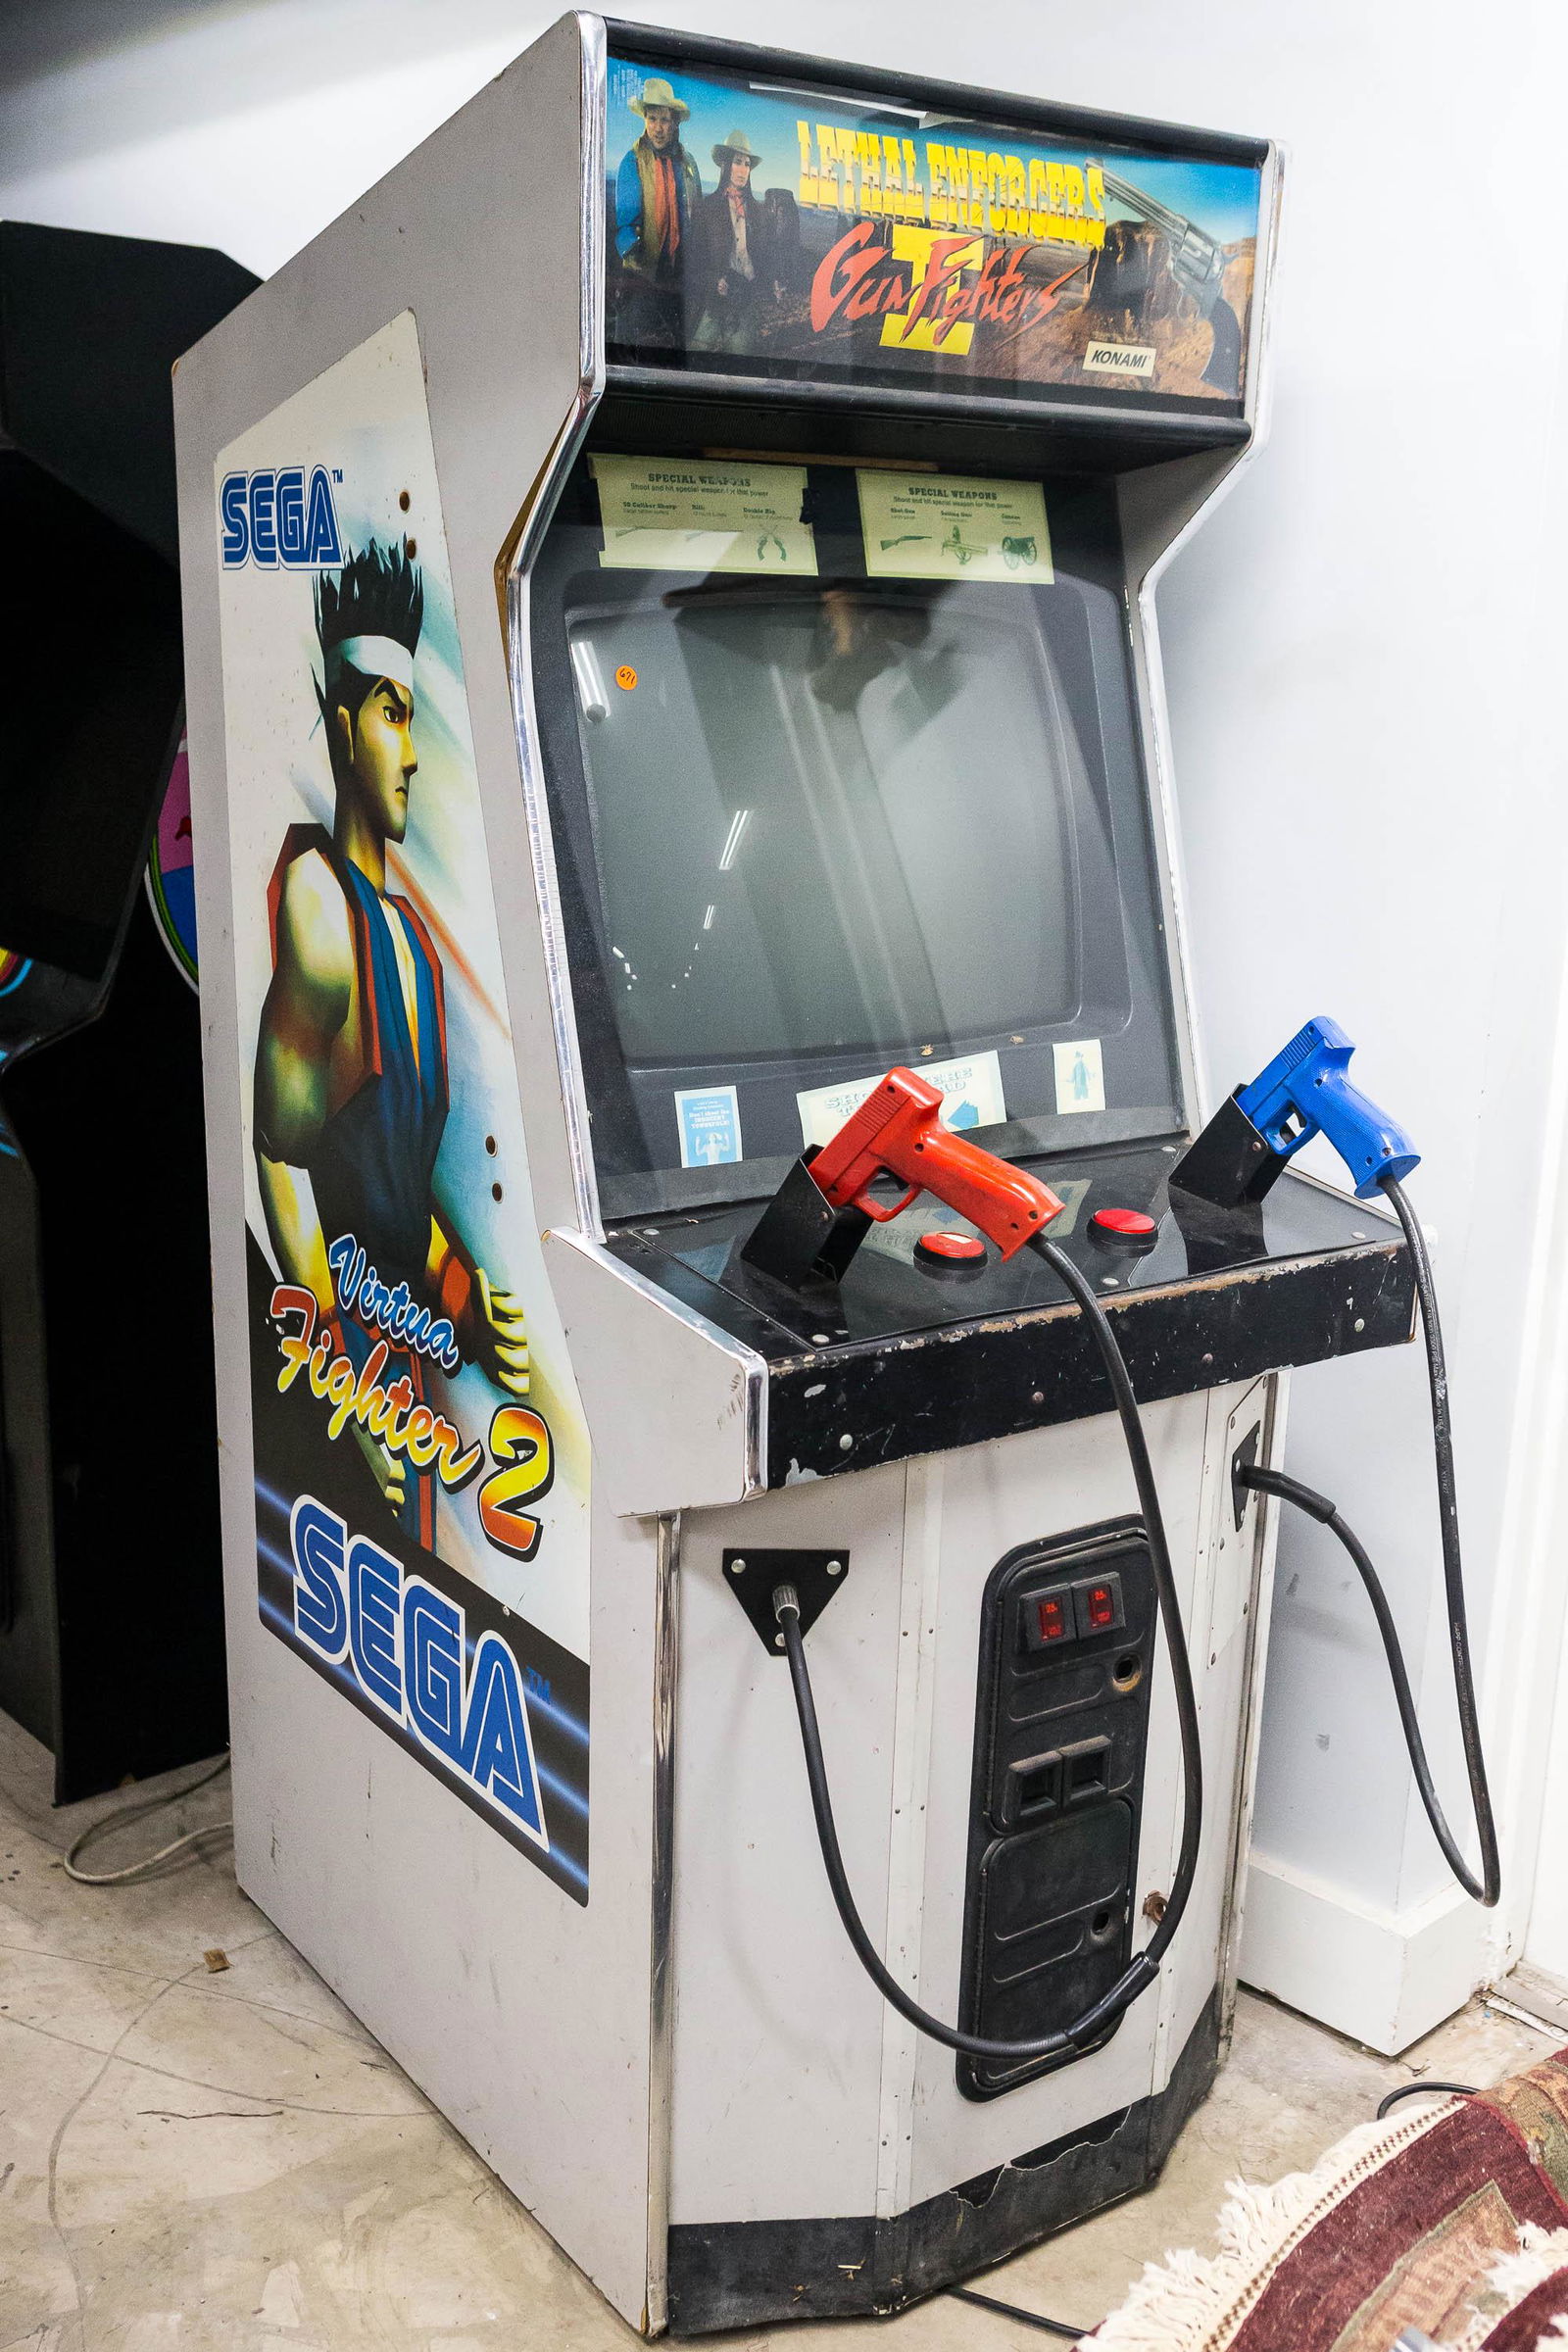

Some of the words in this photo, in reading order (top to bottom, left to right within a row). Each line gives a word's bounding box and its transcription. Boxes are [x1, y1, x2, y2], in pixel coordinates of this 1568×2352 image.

[797, 121, 925, 222] LETHAL
[926, 143, 1106, 250] ENFORCERS
[1091, 350, 1148, 368] KONAMI
[220, 465, 345, 570] SEGA
[648, 472, 696, 484] SPECIAL
[908, 487, 949, 498] SPECIAL
[951, 490, 998, 500] WEAPONS
[329, 1233, 461, 1378] Virtua
[267, 1282, 485, 1493] Fighter
[477, 1402, 554, 1562] 2
[292, 1494, 550, 1853] SEGA
